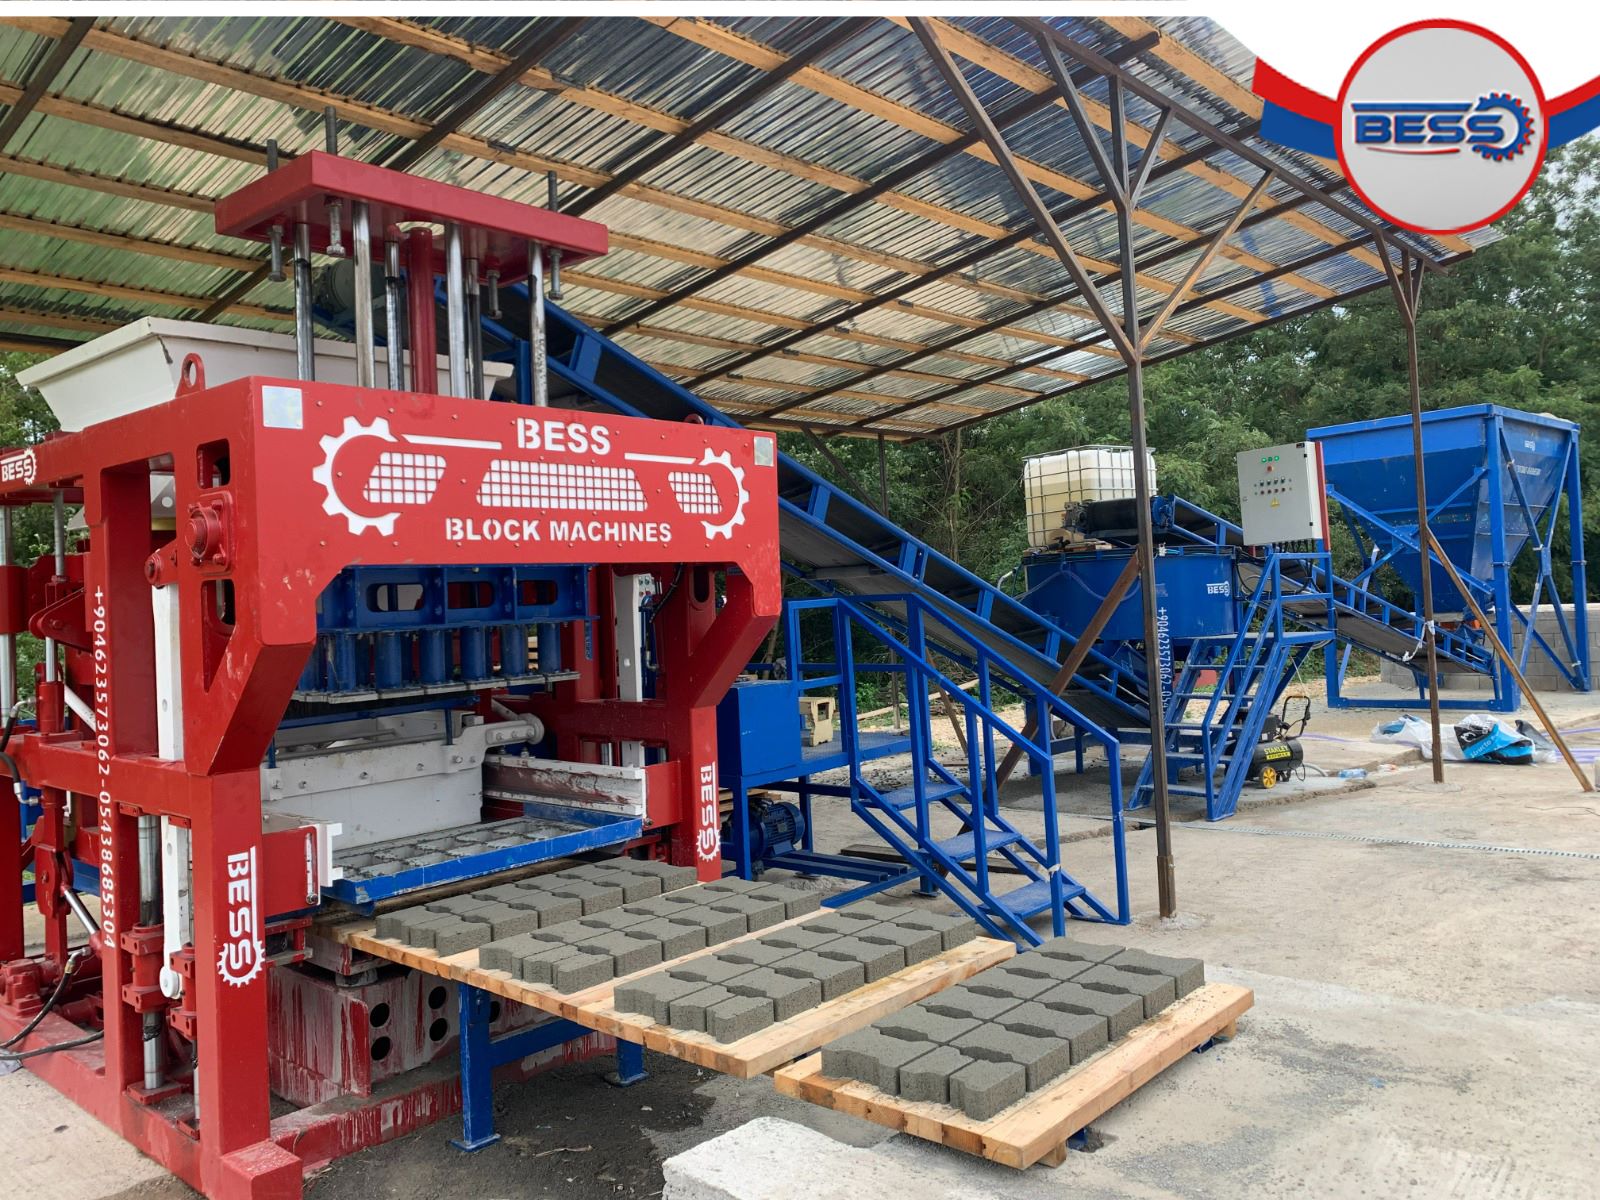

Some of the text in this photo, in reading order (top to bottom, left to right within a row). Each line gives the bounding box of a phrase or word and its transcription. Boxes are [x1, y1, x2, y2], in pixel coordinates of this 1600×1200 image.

[517, 417, 611, 456] BESS
[1, 458, 32, 482] BESS
[445, 517, 673, 543] BLOCK MACHINES
[1207, 584, 1229, 595] BESS
[93, 585, 116, 949] +904623573062-05438685304
[701, 765, 714, 850] BESS
[227, 852, 252, 970] BESS
